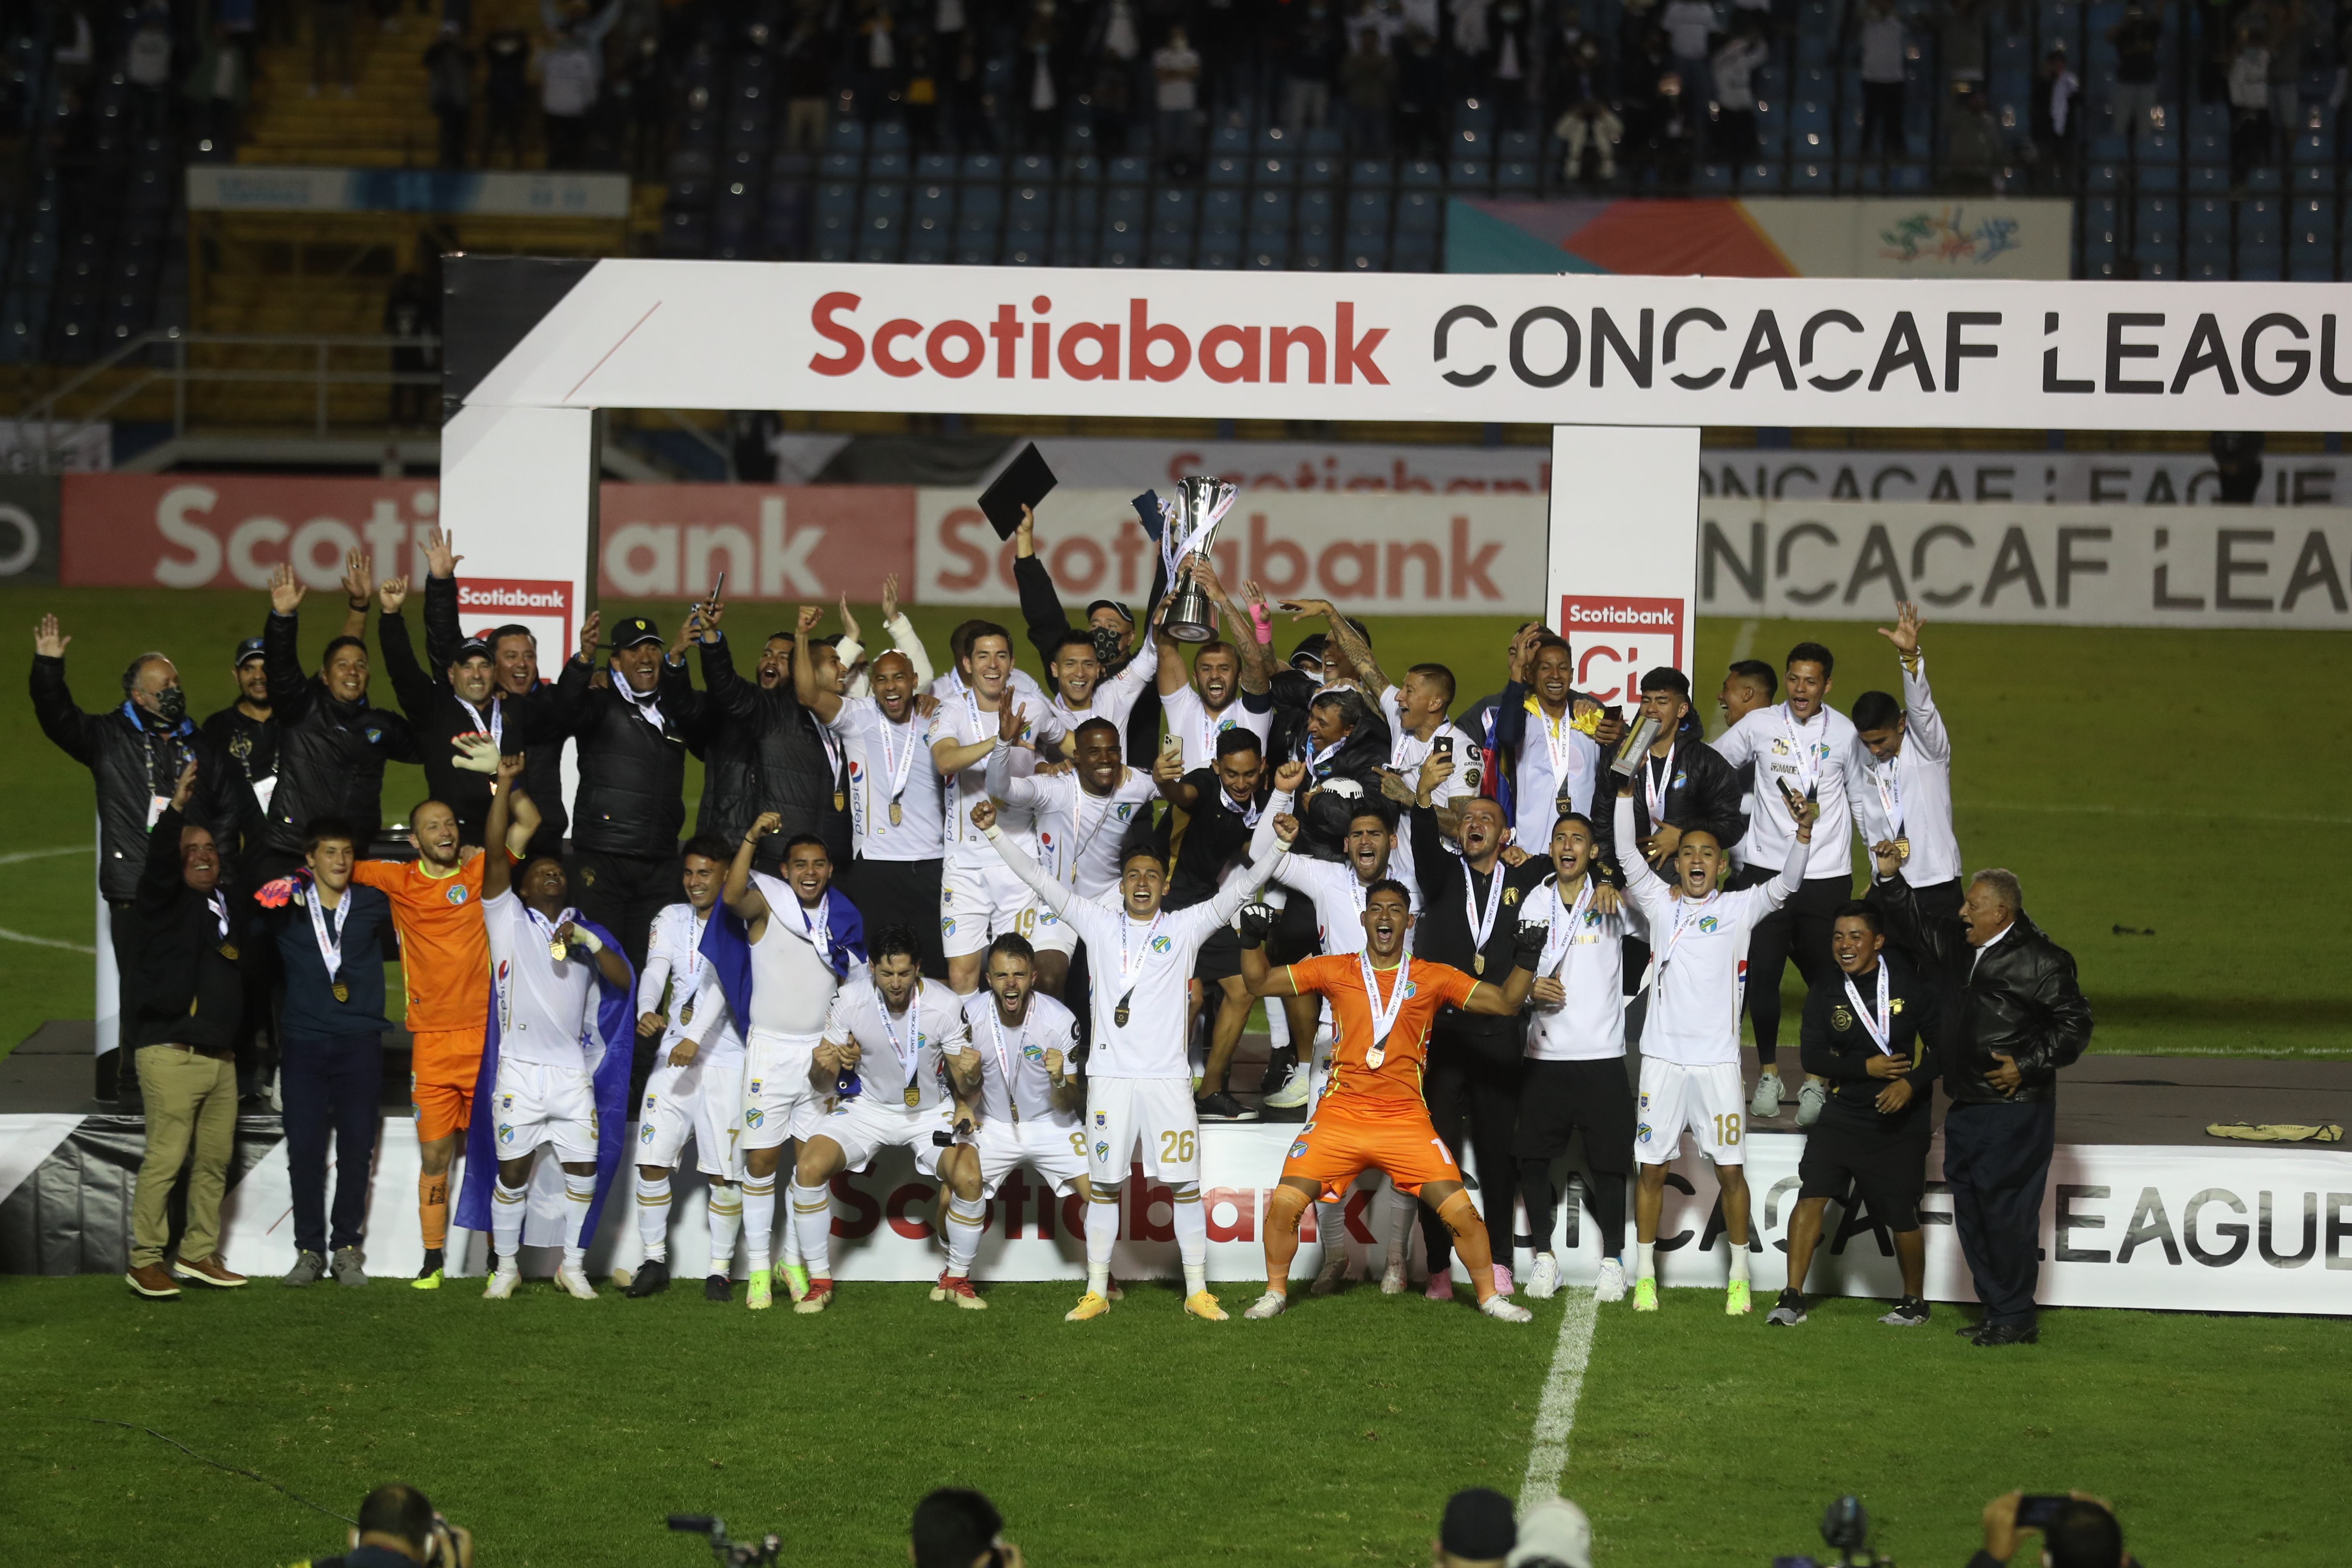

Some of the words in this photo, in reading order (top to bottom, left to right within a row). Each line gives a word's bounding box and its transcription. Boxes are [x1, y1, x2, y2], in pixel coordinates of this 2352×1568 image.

[808, 291, 1391, 386] Scotiabank
[1434, 305, 2002, 392] CONCACAF
[2043, 311, 2352, 396] LEAGU
[1213, 497, 1233, 520] Scotiabank
[1702, 521, 2113, 610] NCACAF
[2152, 527, 2352, 613] LEA
[459, 585, 565, 608] Scotiabank
[1570, 604, 1675, 625] Scotiabank
[1578, 645, 1642, 704] CL
[906, 732, 915, 755] CONCACAF
[1626, 747, 1637, 762] YOUNG
[1635, 731, 1646, 747] PLAYER
[1771, 738, 1790, 756] 36
[1787, 726, 1798, 750] CONCACAF
[1795, 749, 1804, 766] LEAGUE
[901, 756, 911, 773] LEAGUE
[1779, 764, 1797, 775] MADE
[851, 787, 864, 836] pepsi
[946, 794, 954, 842] pepsi
[1353, 886, 1362, 912] CONCACAF
[1577, 887, 1588, 909] Scotiabank
[1014, 908, 1035, 939] 19
[1567, 909, 1580, 932] CONCACAF
[1141, 931, 1154, 953] CONCACAF
[1365, 971, 1375, 993] CONCACAF
[1396, 975, 1404, 998] CONCACAF
[1390, 998, 1398, 1017] LEAGUE
[882, 1014, 894, 1038] CONCACAF
[992, 1021, 1003, 1047] CONCACAF
[998, 1047, 1008, 1073] Scotiabank
[906, 1094, 918, 1102] CL
[1714, 1113, 1740, 1145] 18
[727, 1129, 740, 1161] 7
[1069, 1132, 1088, 1157] 8
[1161, 1130, 1195, 1163] 26
[1430, 1137, 1453, 1165] 1
[2038, 1183, 2352, 1271] EAGUE
